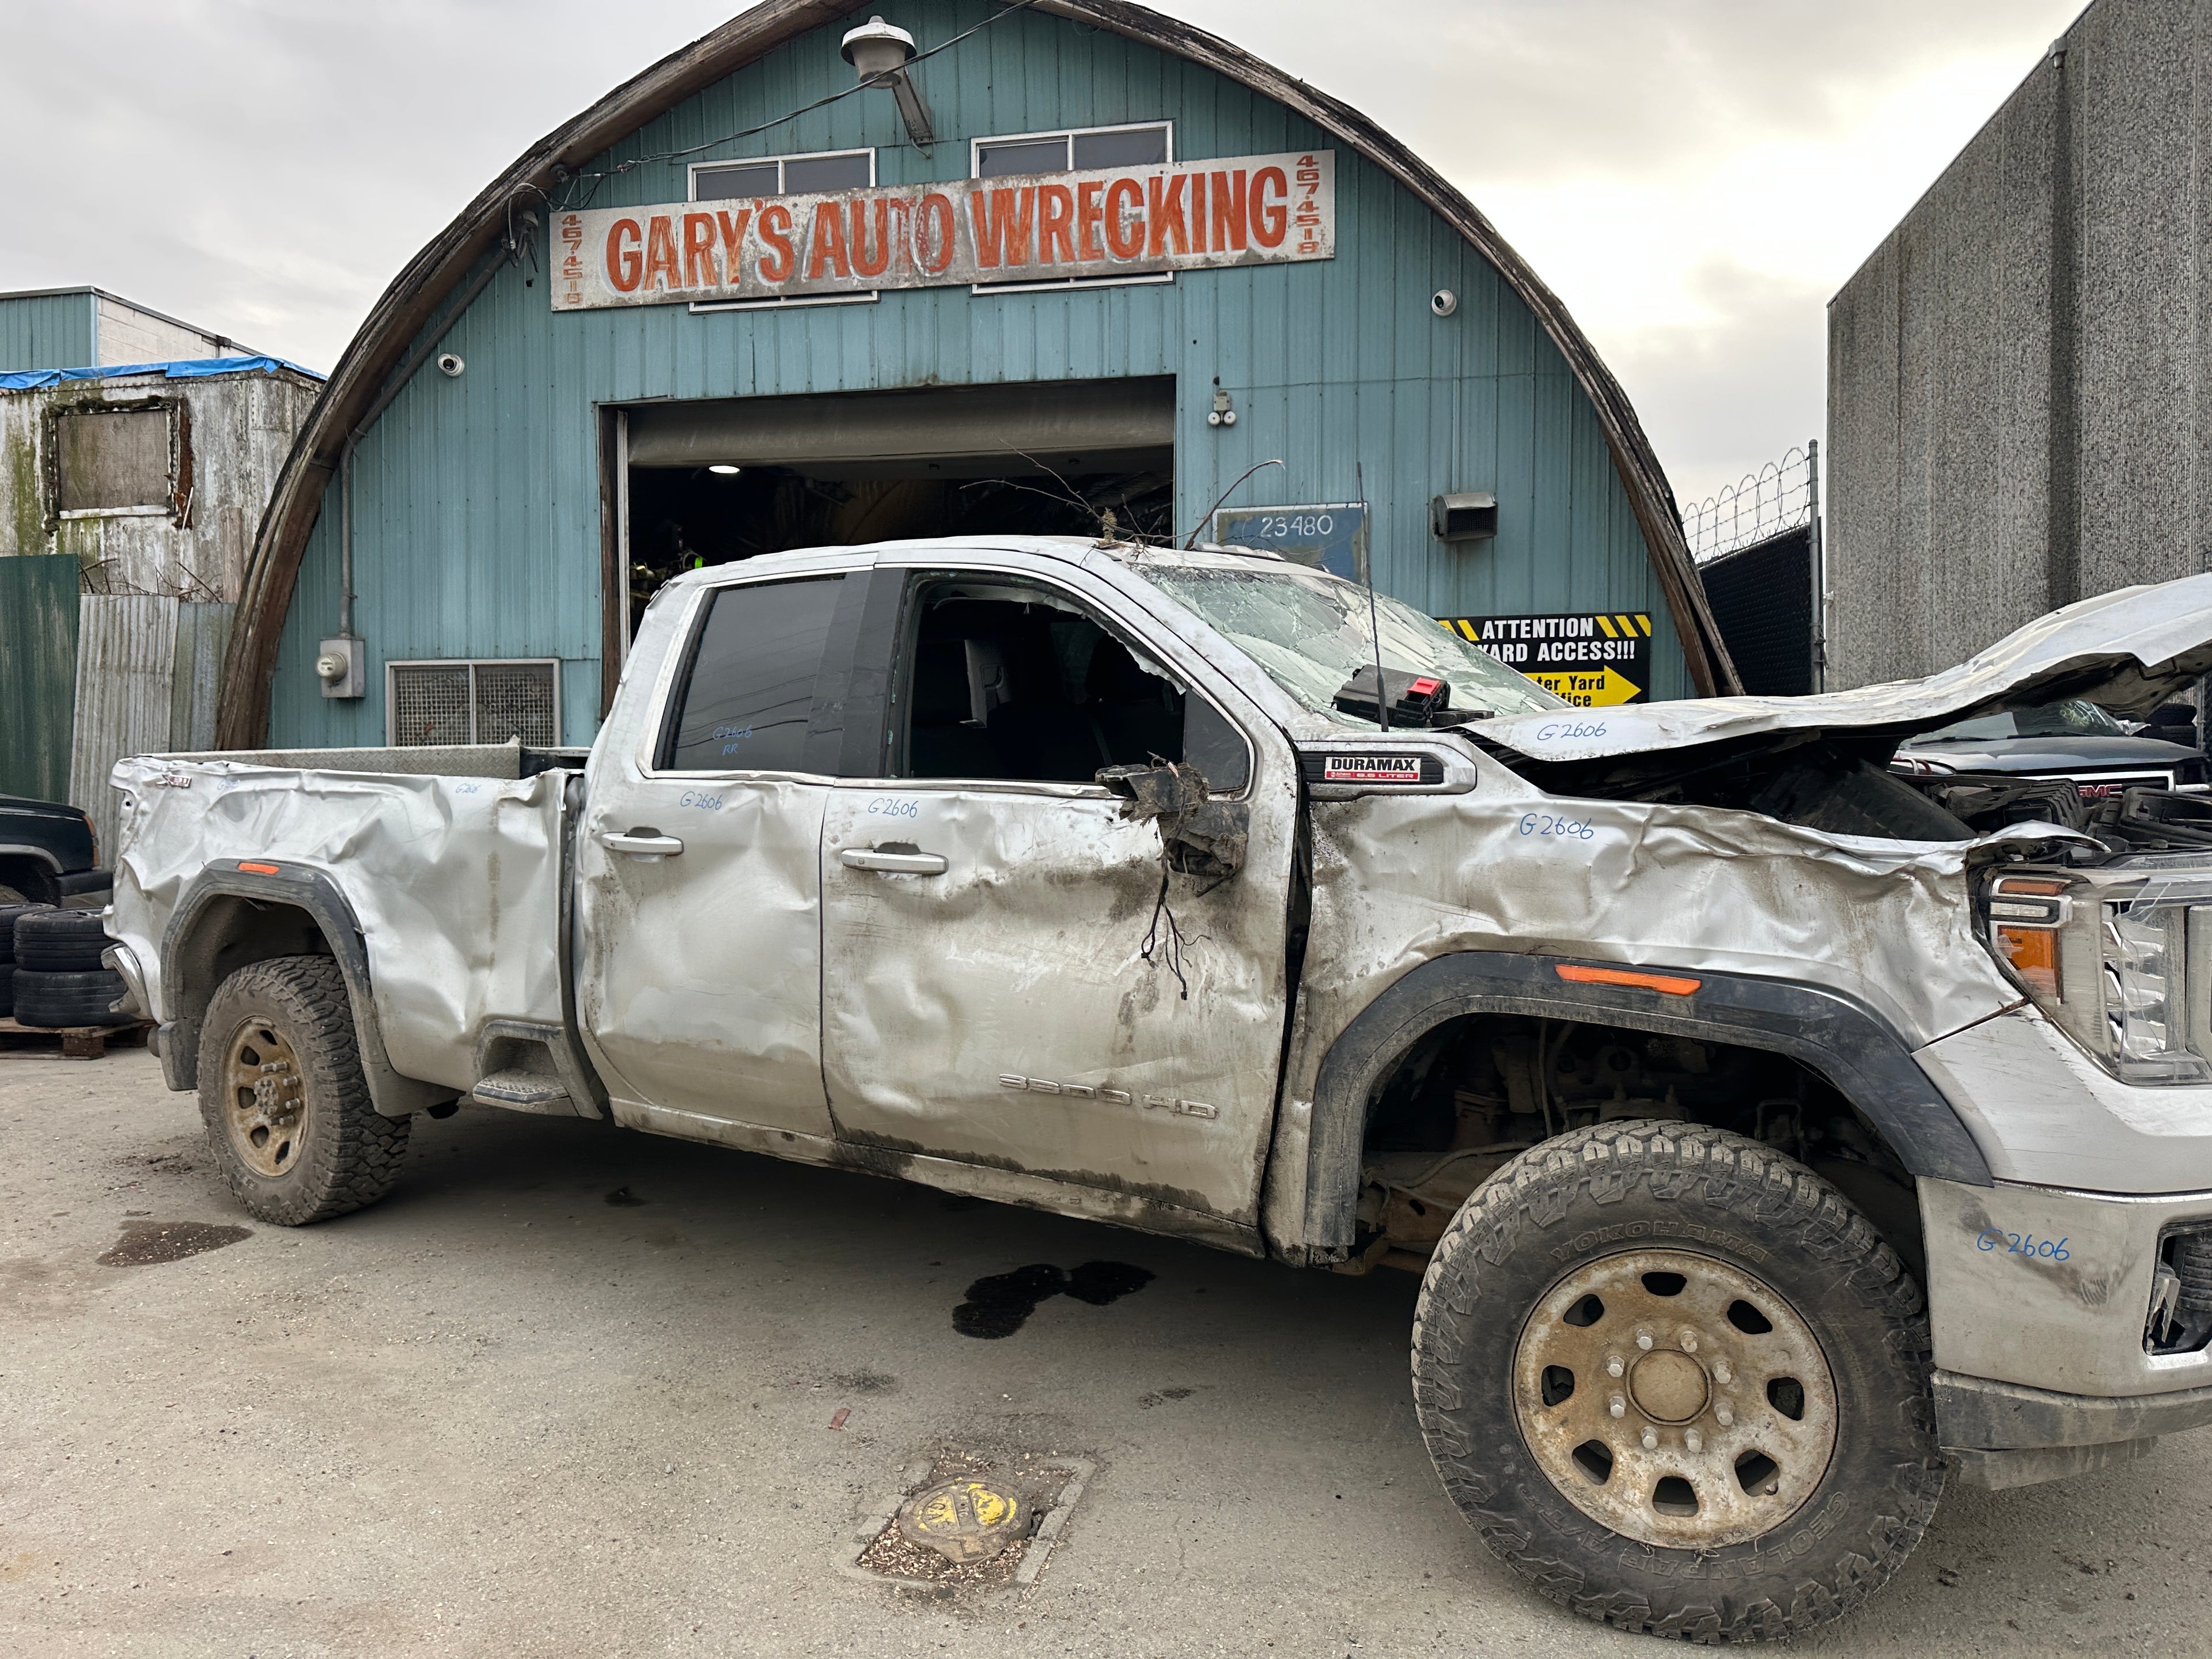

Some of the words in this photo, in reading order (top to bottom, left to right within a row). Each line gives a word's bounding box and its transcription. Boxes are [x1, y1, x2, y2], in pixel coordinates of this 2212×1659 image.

[607, 200, 794, 292] GARY'S
[809, 194, 954, 279] AUTO
[971, 166, 1287, 268] WRECKING
[1260, 515, 1333, 537] 23480
[1482, 618, 1593, 639] ATTENTION
[1537, 641, 1635, 661] ACCESS!!!
[1569, 675, 1604, 690] Yard
[713, 724, 752, 740] G2606
[1537, 722, 1607, 740] G2606
[722, 744, 738, 756] RR
[1331, 758, 1415, 771] DURAMAX
[680, 791, 722, 810] G2606
[868, 798, 919, 818] G2606
[1520, 813, 1594, 839] G2606
[1550, 1219, 1768, 1264] YOKOHAMA
[1977, 1228, 2070, 1260] G2606
